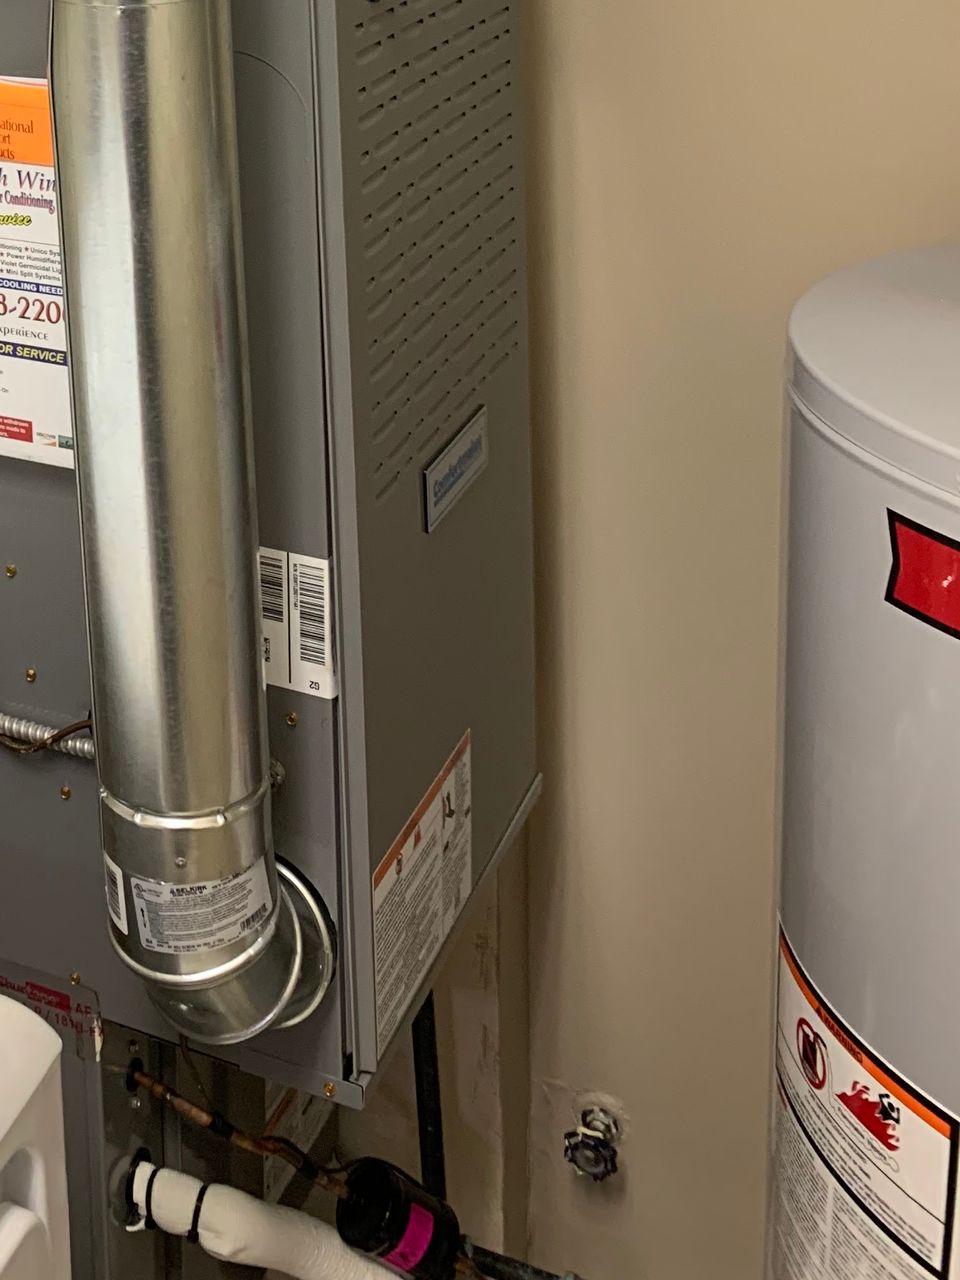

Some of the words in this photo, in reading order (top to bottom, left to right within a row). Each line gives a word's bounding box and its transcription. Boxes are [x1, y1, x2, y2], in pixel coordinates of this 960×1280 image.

[6, 252, 25, 260] Power
[18, 262, 50, 272] Germicidal
[20, 270, 34, 278] Split
[38, 285, 62, 295] NEED
[16, 347, 65, 363] SERVICE
[309, 680, 320, 691] G2
